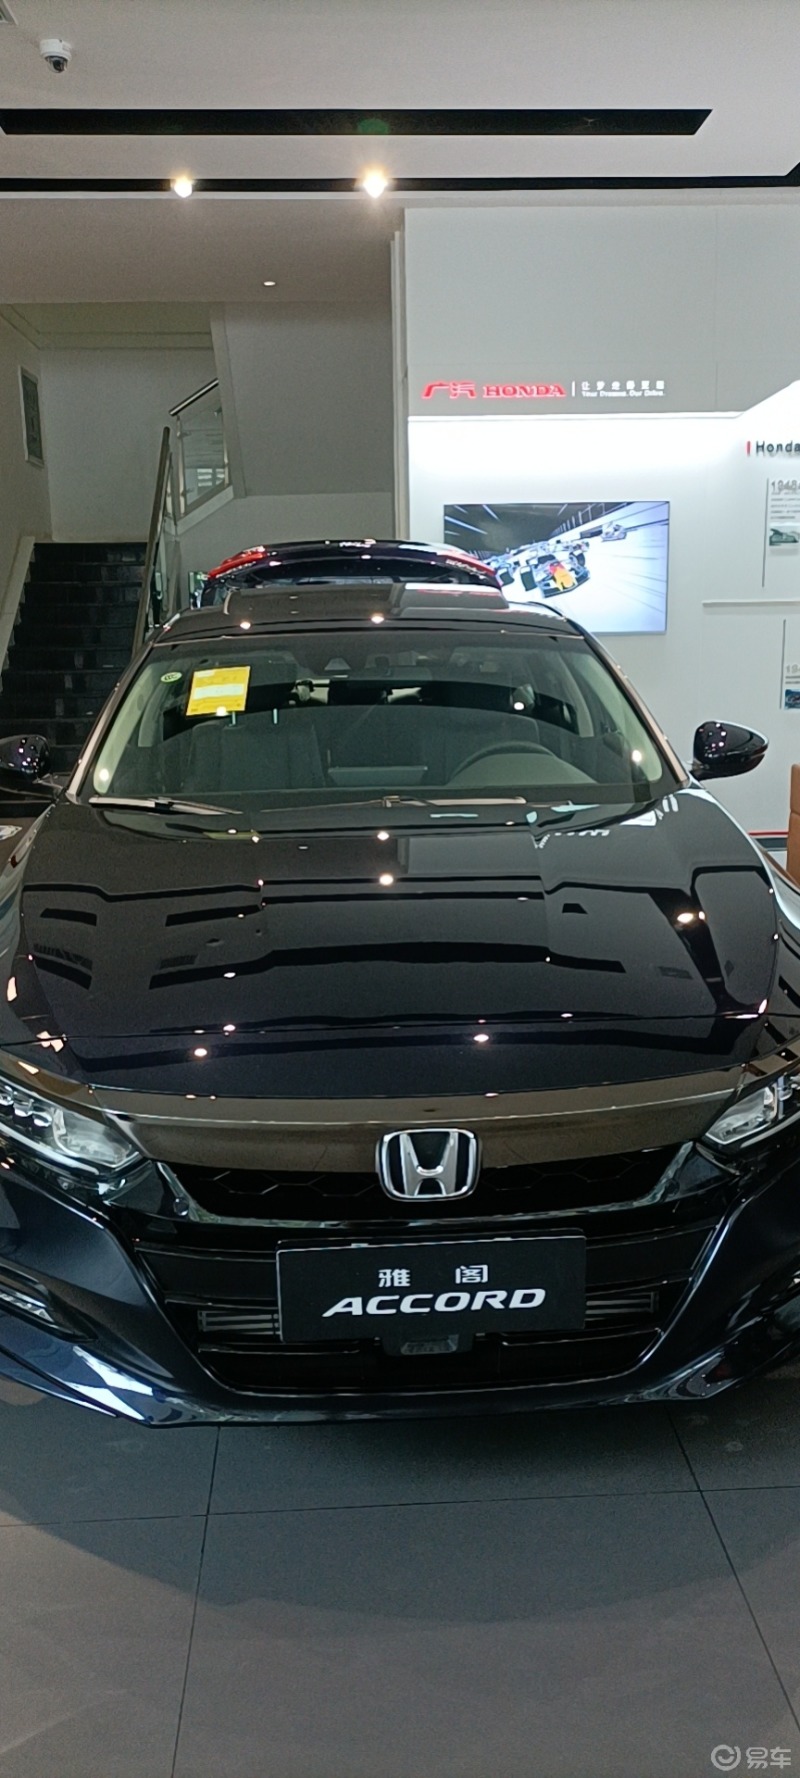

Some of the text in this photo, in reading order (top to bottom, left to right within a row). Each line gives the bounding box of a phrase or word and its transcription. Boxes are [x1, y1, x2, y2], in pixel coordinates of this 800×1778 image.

[422, 381, 476, 398] 广汽
[483, 384, 566, 398] HONDA
[756, 440, 800, 454] Honda
[322, 1288, 546, 1317] ACCORD
